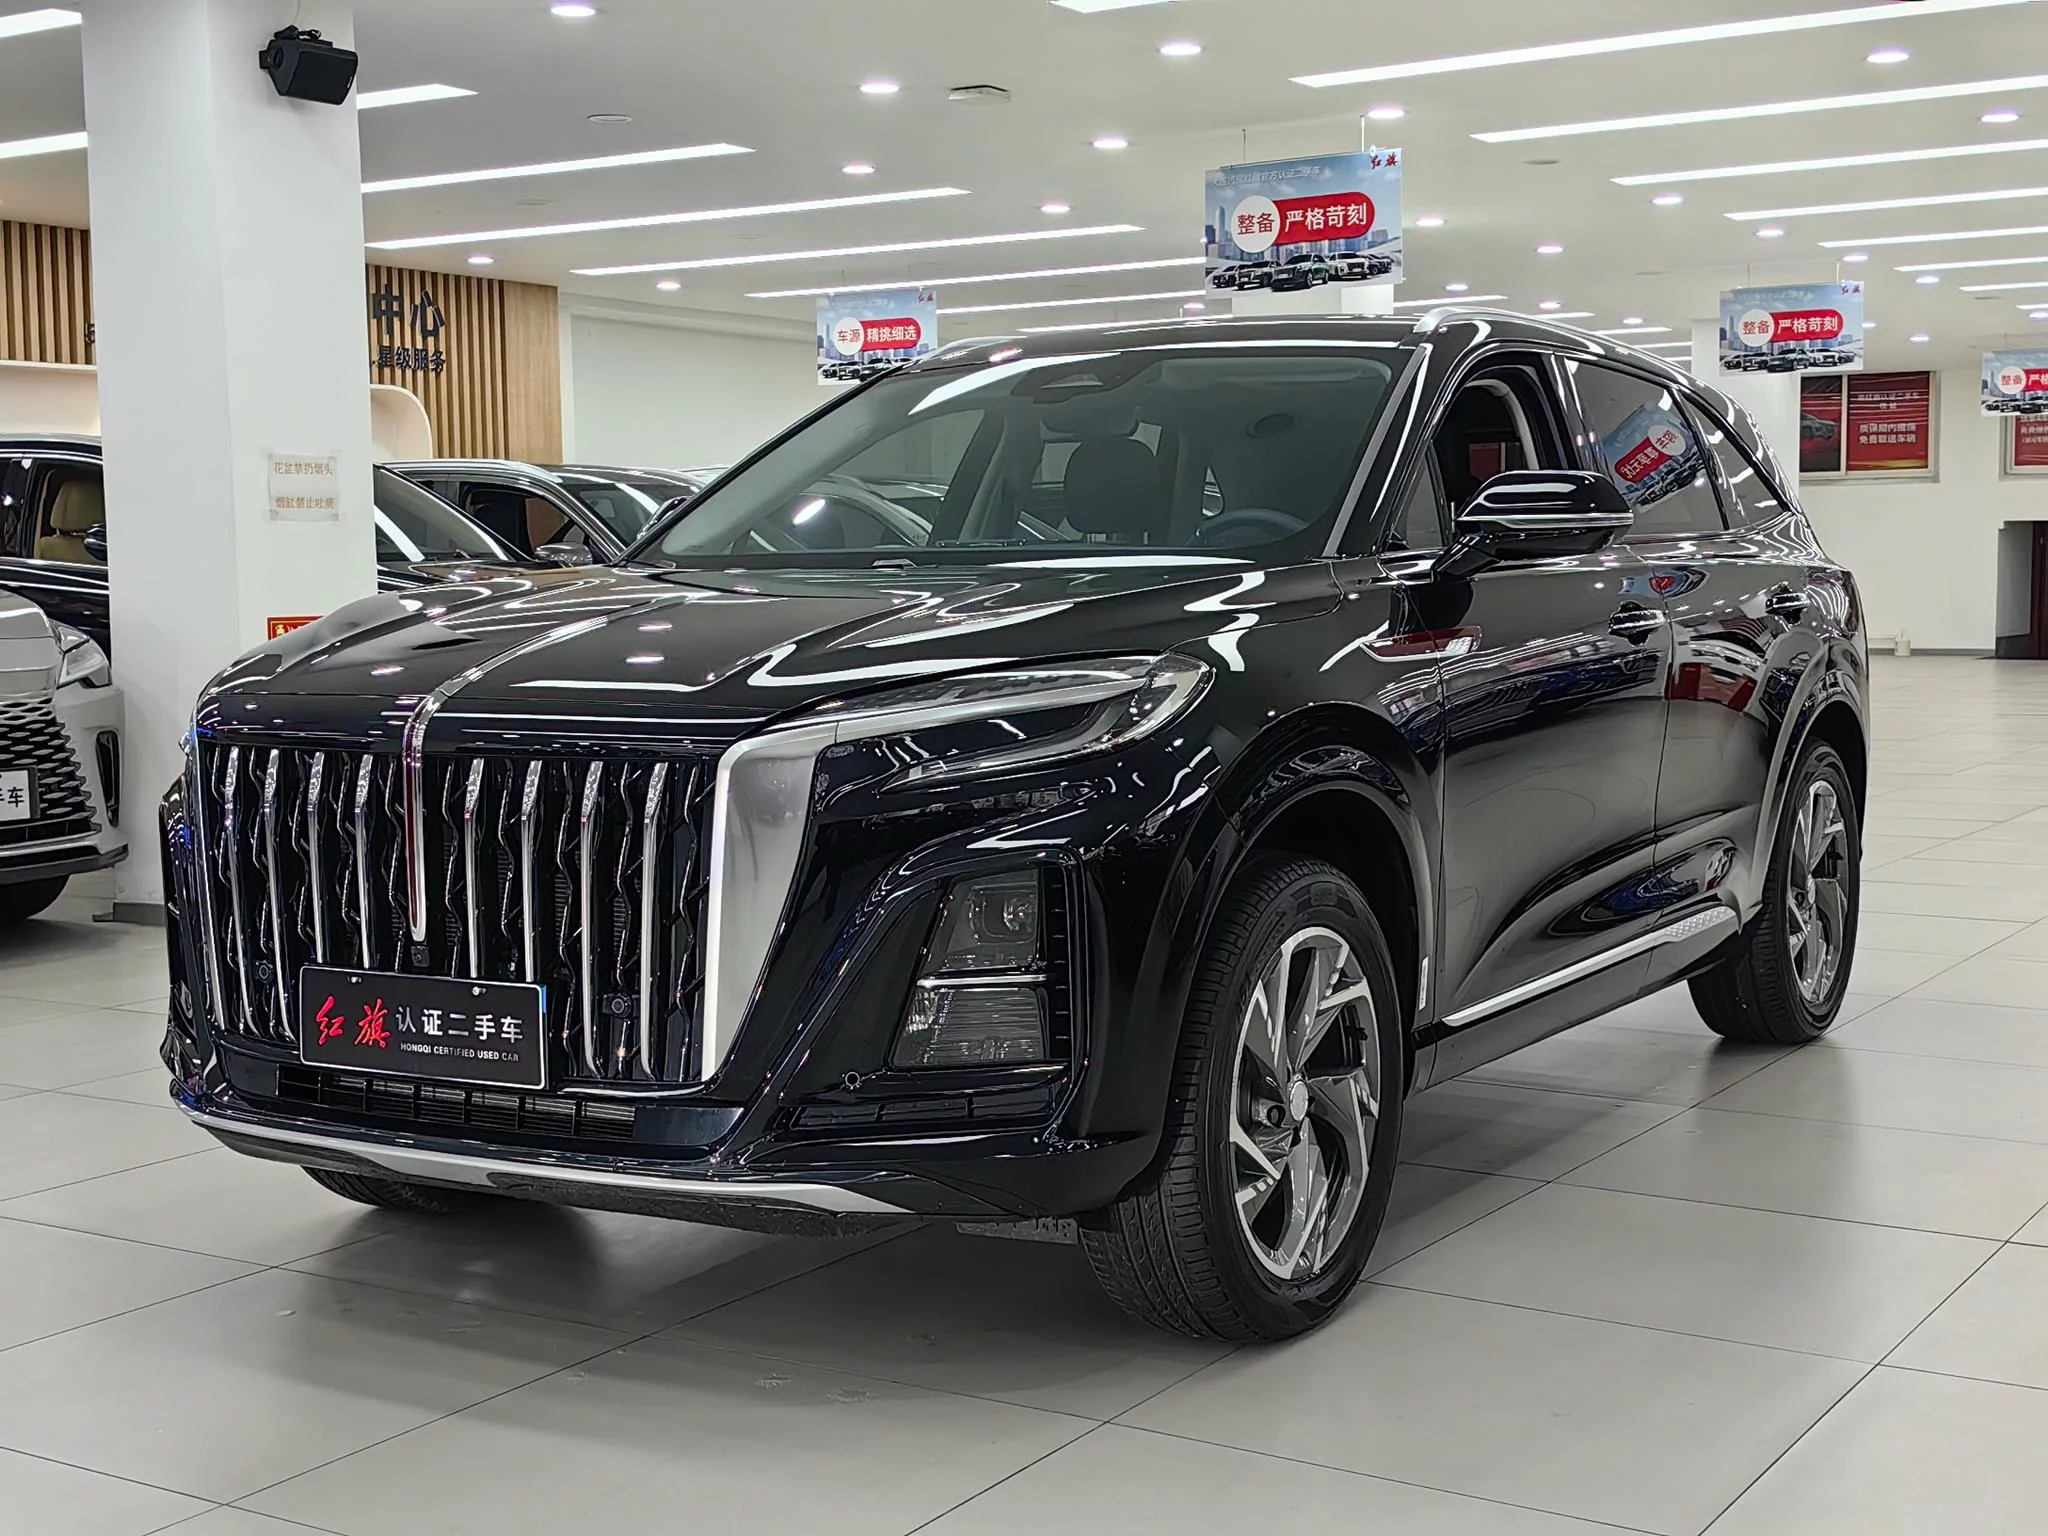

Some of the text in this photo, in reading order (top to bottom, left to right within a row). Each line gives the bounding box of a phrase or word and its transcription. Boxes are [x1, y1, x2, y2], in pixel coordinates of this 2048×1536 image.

[1370, 152, 1398, 170] 红旗
[1236, 202, 1367, 235] 整备 严格苛刻
[372, 283, 446, 337] 中心
[837, 325, 917, 344] 车源 精挑细选
[1742, 315, 1838, 335] 整备 严格苛刻
[377, 345, 446, 372] 星级服务
[272, 462, 333, 475] 花盆禁扔烟头
[275, 496, 335, 509] 烟缸禁止吐痰
[0, 786, 24, 808] 车
[315, 995, 523, 1049] 红旗 认证二手车
[400, 1042, 519, 1062] HONGQI CERTIFIED USED CAR
